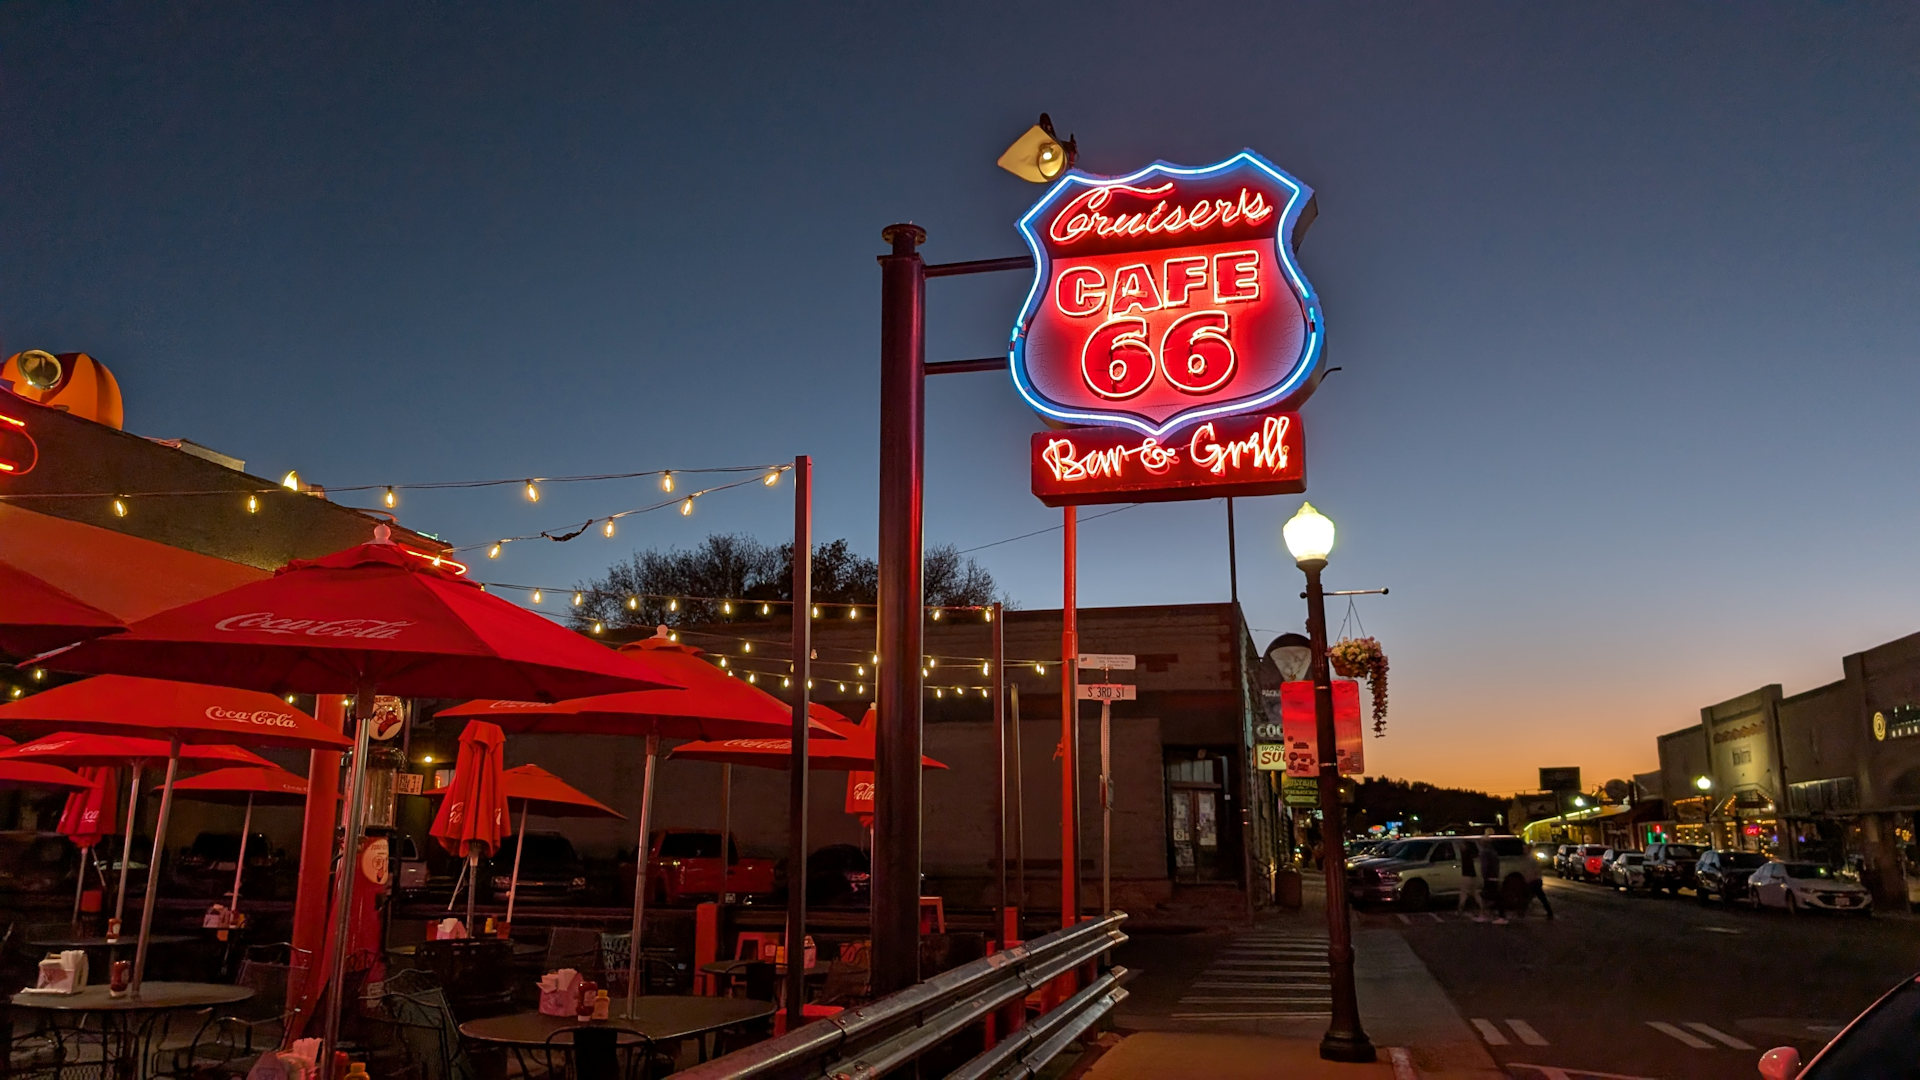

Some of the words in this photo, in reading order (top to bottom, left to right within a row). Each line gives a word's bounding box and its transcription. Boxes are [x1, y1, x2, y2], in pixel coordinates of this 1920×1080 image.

[1049, 182, 1273, 245] Cruiser's
[1055, 249, 1260, 321] CAFE
[1081, 309, 1236, 399] 66
[1042, 437, 1128, 482] Bar
[1140, 437, 1180, 475] &
[1190, 416, 1291, 474] Grill
[214, 612, 416, 640] Coca-Cola
[204, 705, 300, 729] Coca-Cola
[1087, 686, 1093, 698] S
[1096, 686, 1112, 698] 3RD
[1116, 686, 1125, 698] ST
